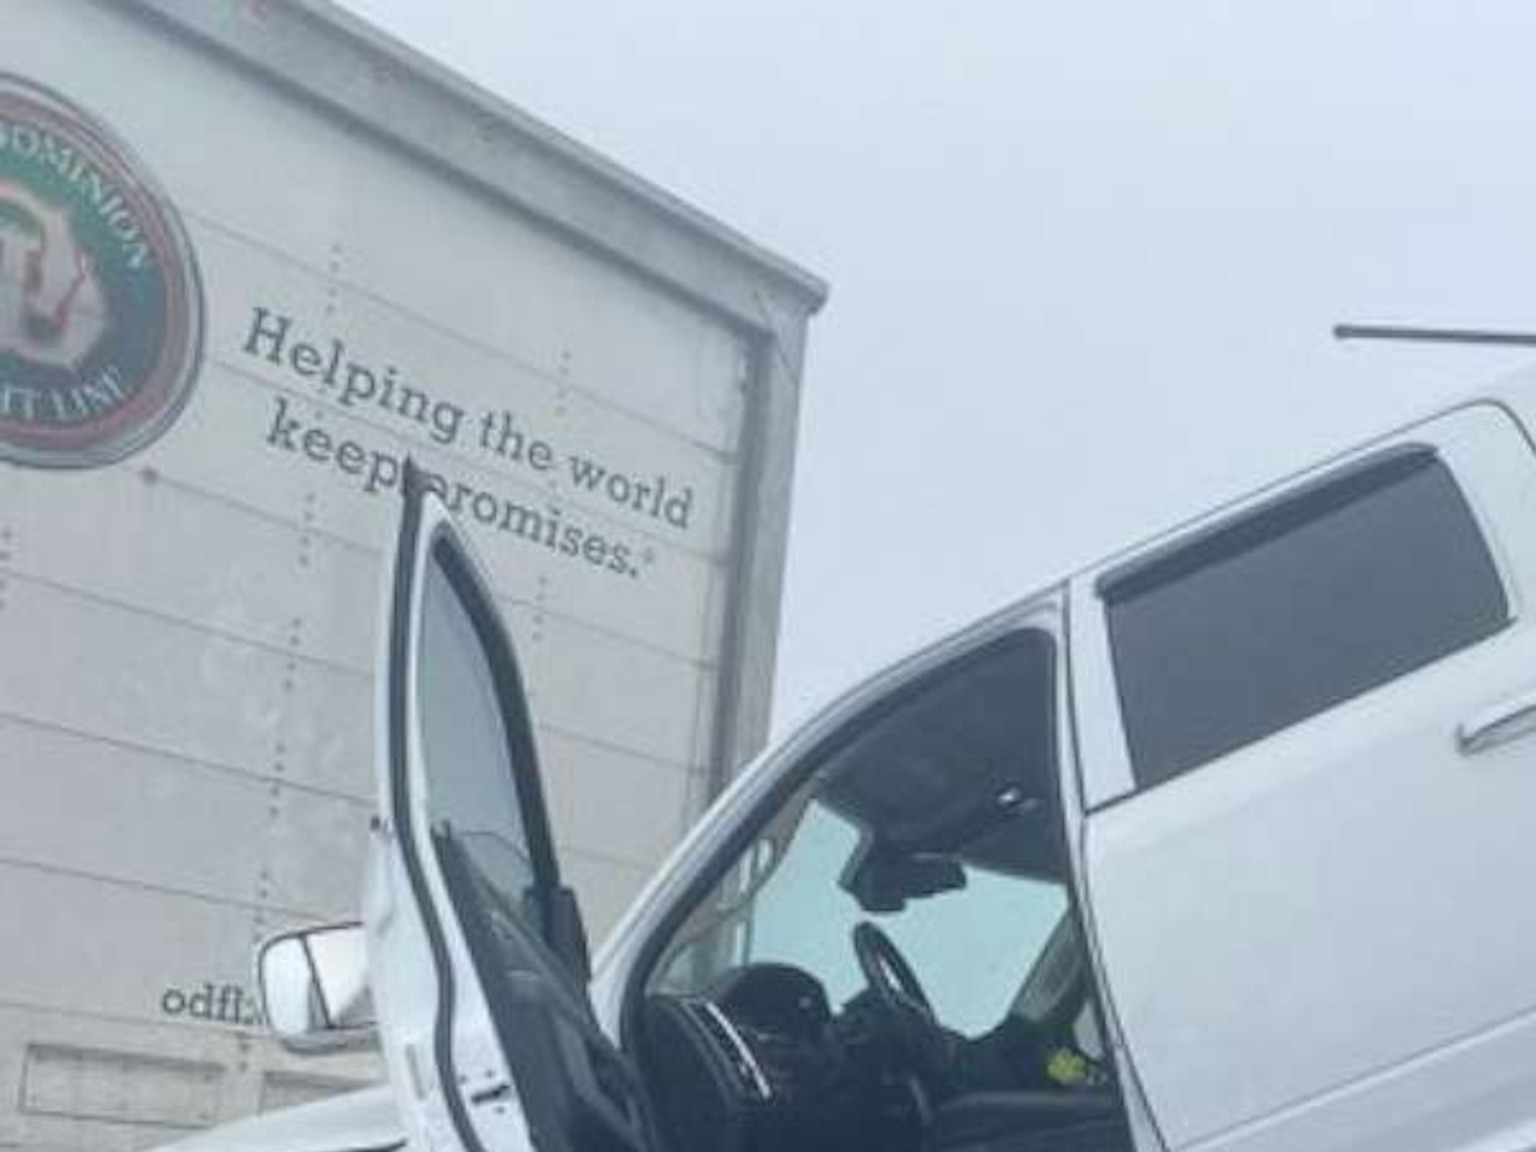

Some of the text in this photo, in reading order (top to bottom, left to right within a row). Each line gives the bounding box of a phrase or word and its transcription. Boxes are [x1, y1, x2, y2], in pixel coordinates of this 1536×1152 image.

[244, 306, 693, 531] Helping the world
[266, 396, 399, 494] keep
